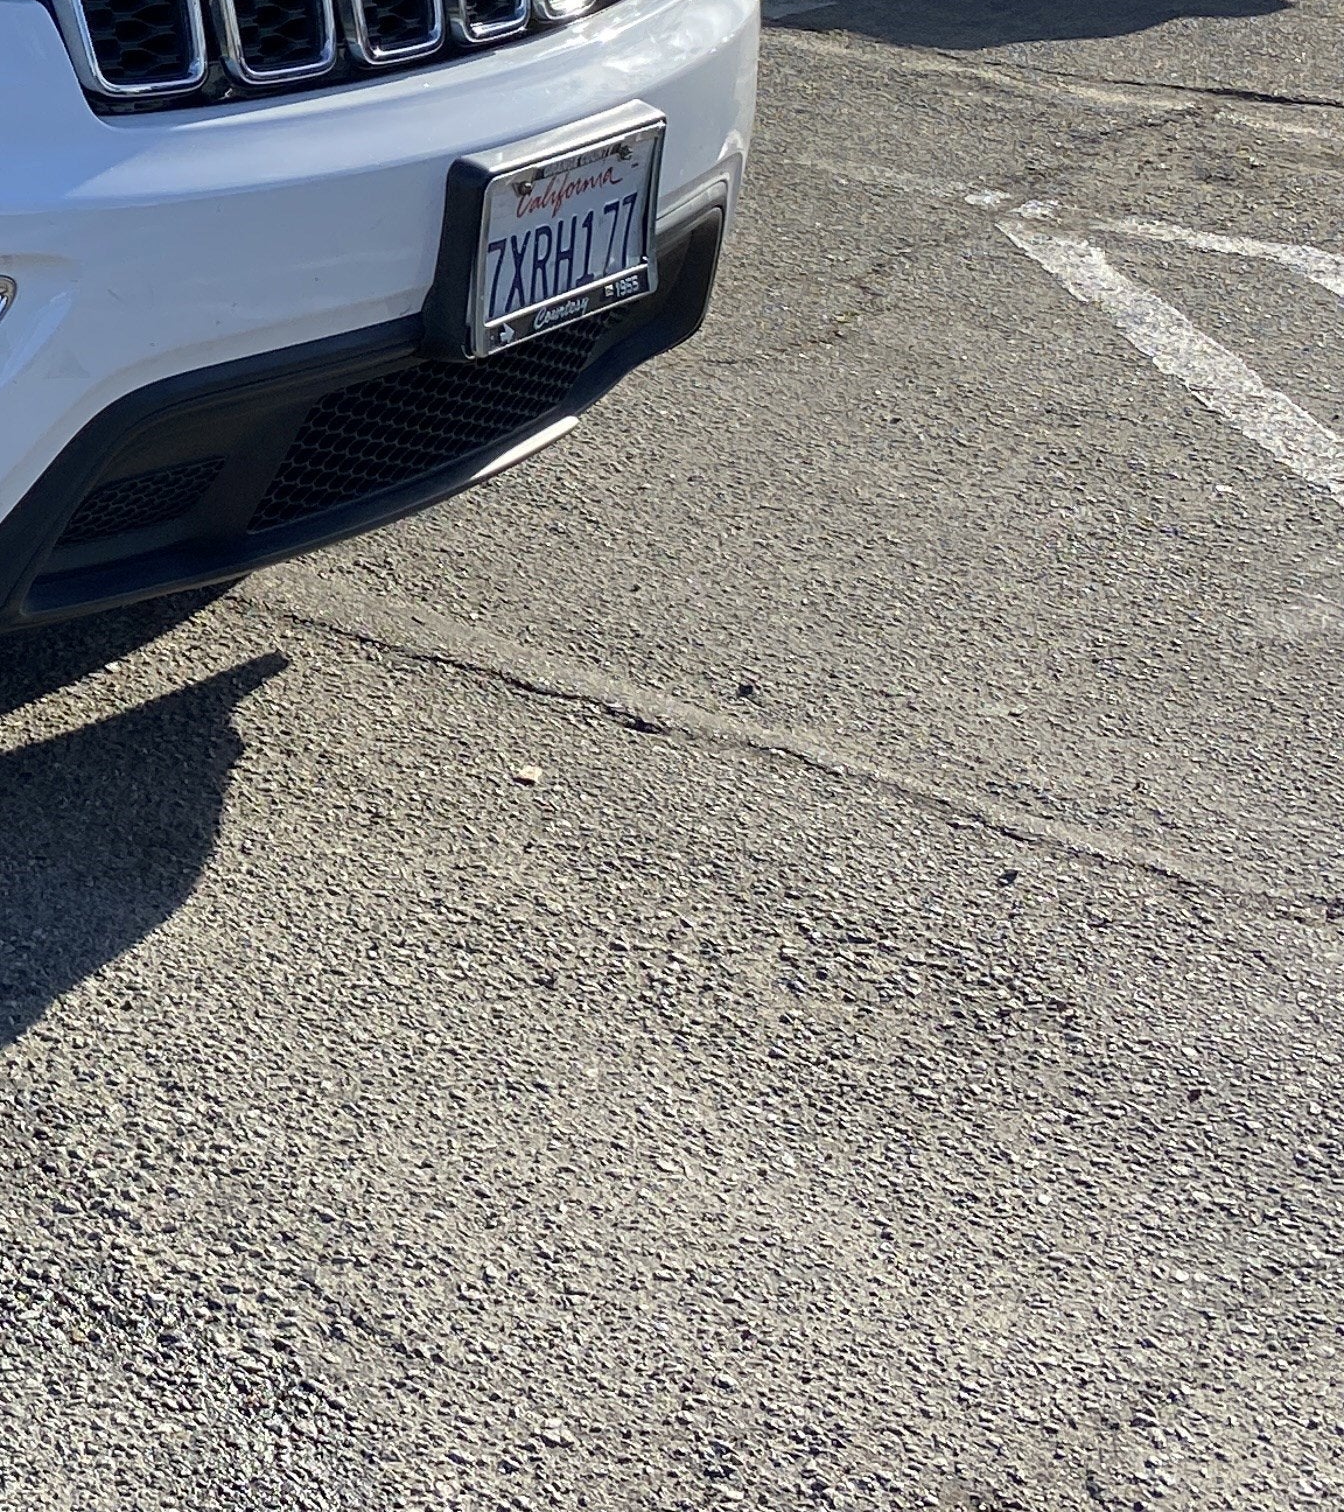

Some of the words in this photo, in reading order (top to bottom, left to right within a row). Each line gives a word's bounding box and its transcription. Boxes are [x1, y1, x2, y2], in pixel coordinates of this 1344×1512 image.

[515, 165, 625, 219] California
[487, 191, 639, 319] 7XRH177
[533, 296, 590, 330] Courtesy
